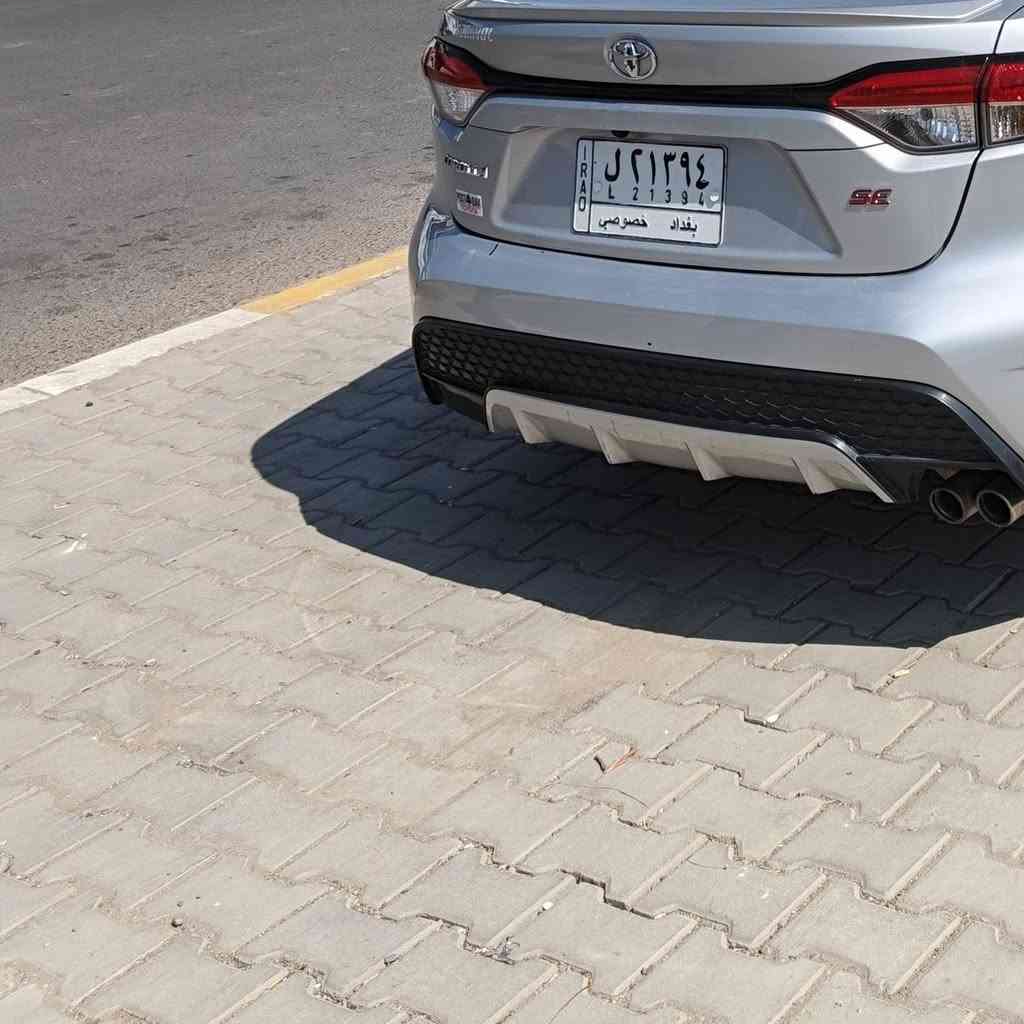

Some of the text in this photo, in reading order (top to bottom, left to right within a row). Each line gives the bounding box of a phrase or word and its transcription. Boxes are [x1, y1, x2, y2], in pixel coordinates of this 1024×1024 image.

[849, 188, 892, 206] SE
[599, 214, 698, 238] بغداد خصوصي
